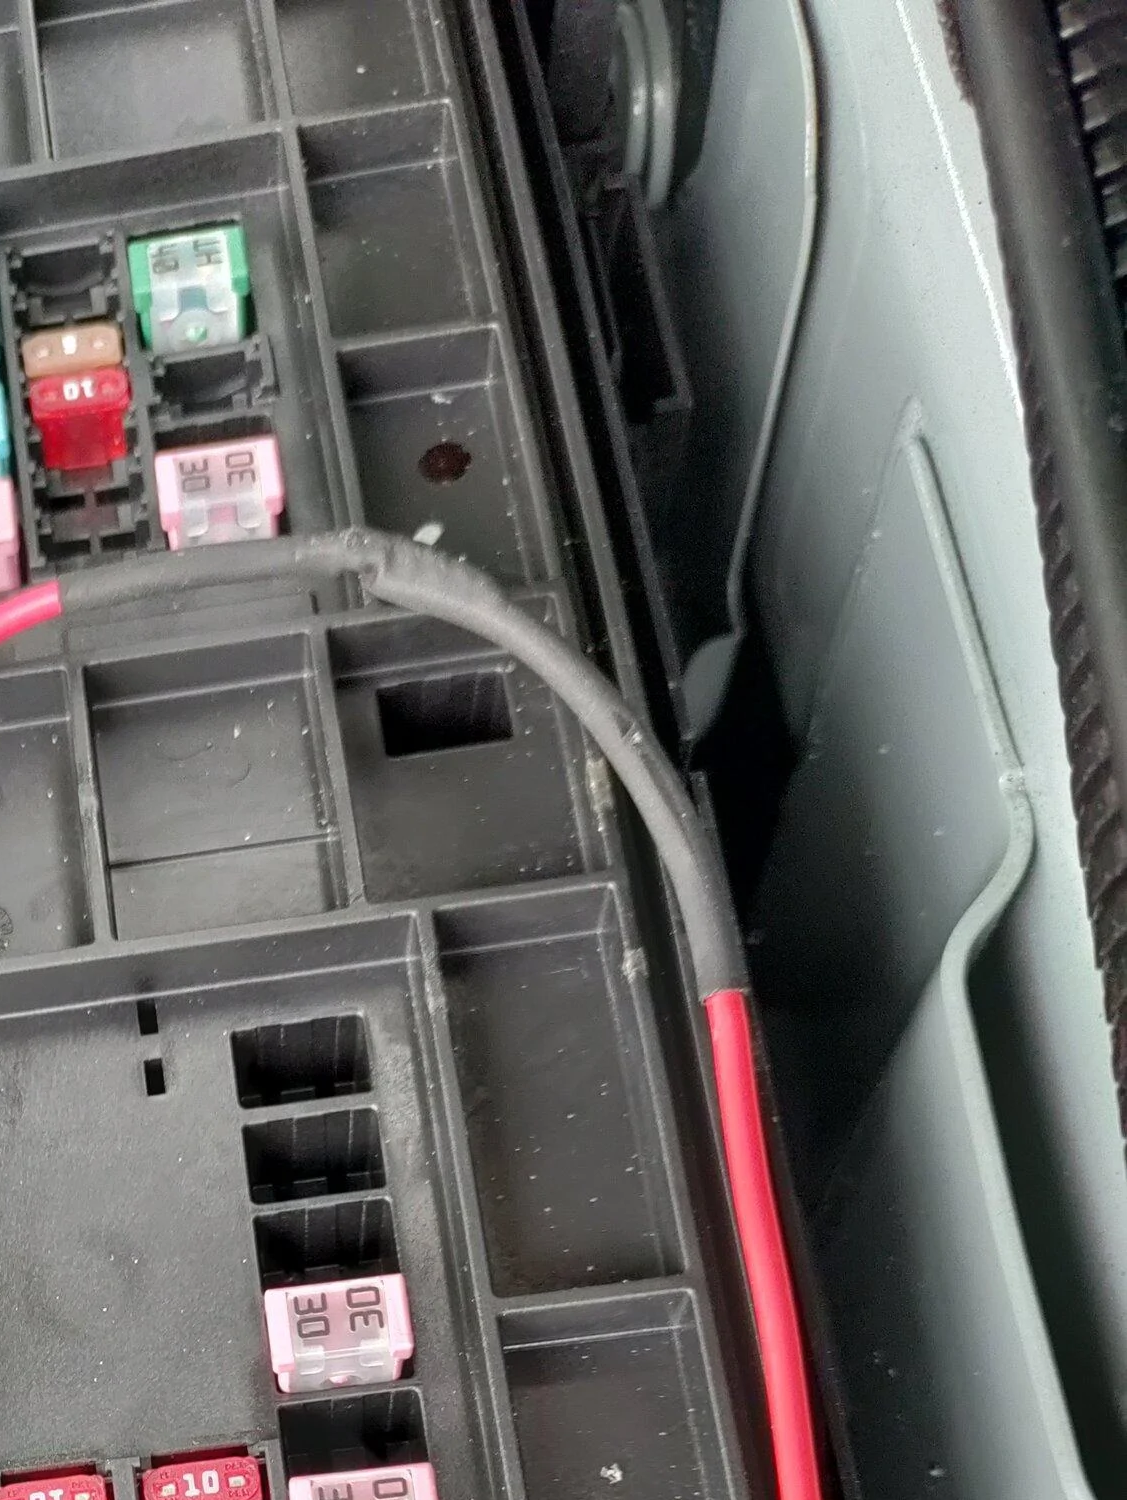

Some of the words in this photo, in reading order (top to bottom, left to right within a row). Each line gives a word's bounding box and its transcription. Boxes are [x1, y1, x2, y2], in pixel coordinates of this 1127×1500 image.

[62, 378, 95, 402] 10
[180, 458, 210, 493] 30
[225, 450, 255, 487] 30
[293, 1291, 331, 1339] 30
[345, 1285, 384, 1332] 30
[182, 1470, 220, 1497] 10
